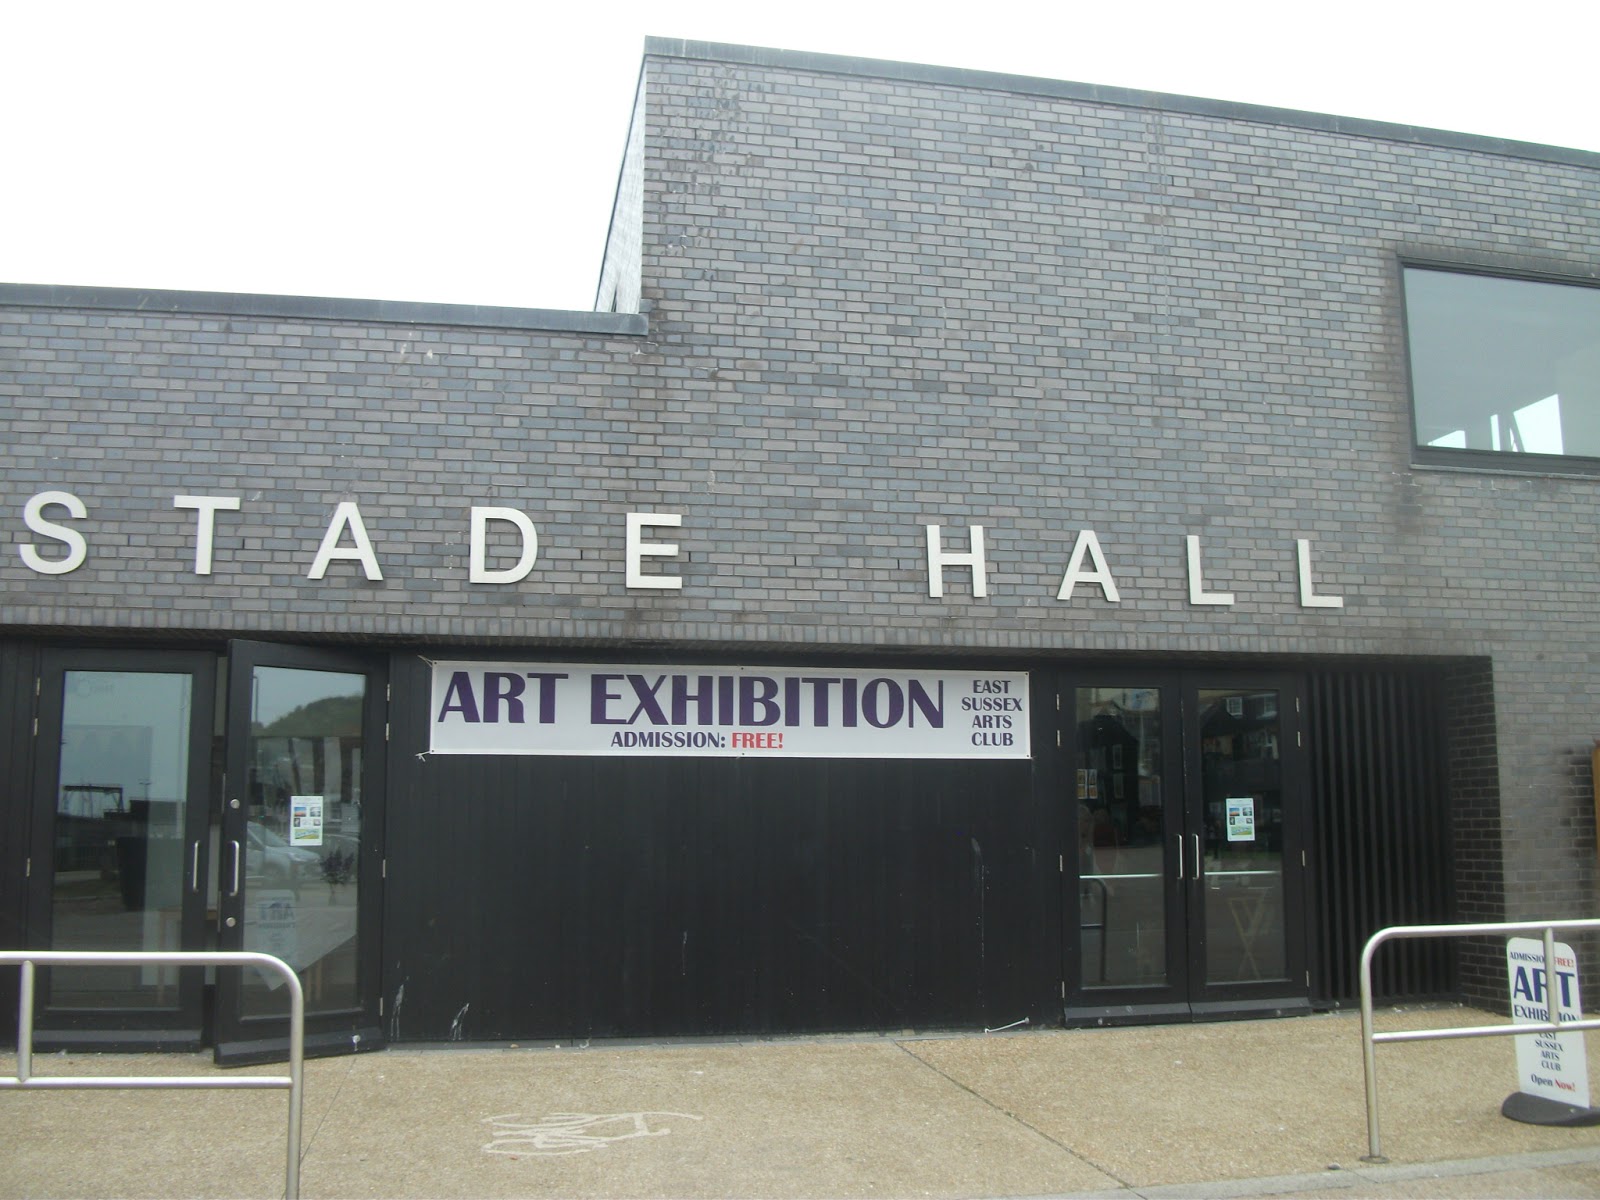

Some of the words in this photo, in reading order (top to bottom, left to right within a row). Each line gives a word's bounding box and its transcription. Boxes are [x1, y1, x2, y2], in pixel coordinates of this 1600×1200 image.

[20, 491, 682, 589] STADE
[926, 524, 1344, 608] HALL
[973, 680, 1011, 693] EAST
[437, 672, 568, 724] ART
[590, 673, 944, 729] EXHIBITION
[961, 697, 1023, 711] SUSSEX
[972, 715, 1012, 728] ARTS
[611, 731, 725, 748] ADMISSION:
[732, 732, 784, 749] FREE!
[971, 732, 1014, 746] CLUB
[1510, 951, 1546, 963] ADMISSIO
[1535, 1040, 1564, 1052] SUSSEX
[1541, 1050, 1560, 1061] ARTS
[1541, 1061, 1562, 1071] CLUB
[1531, 1073, 1553, 1087] Open
[1554, 1078, 1576, 1092] Now!
